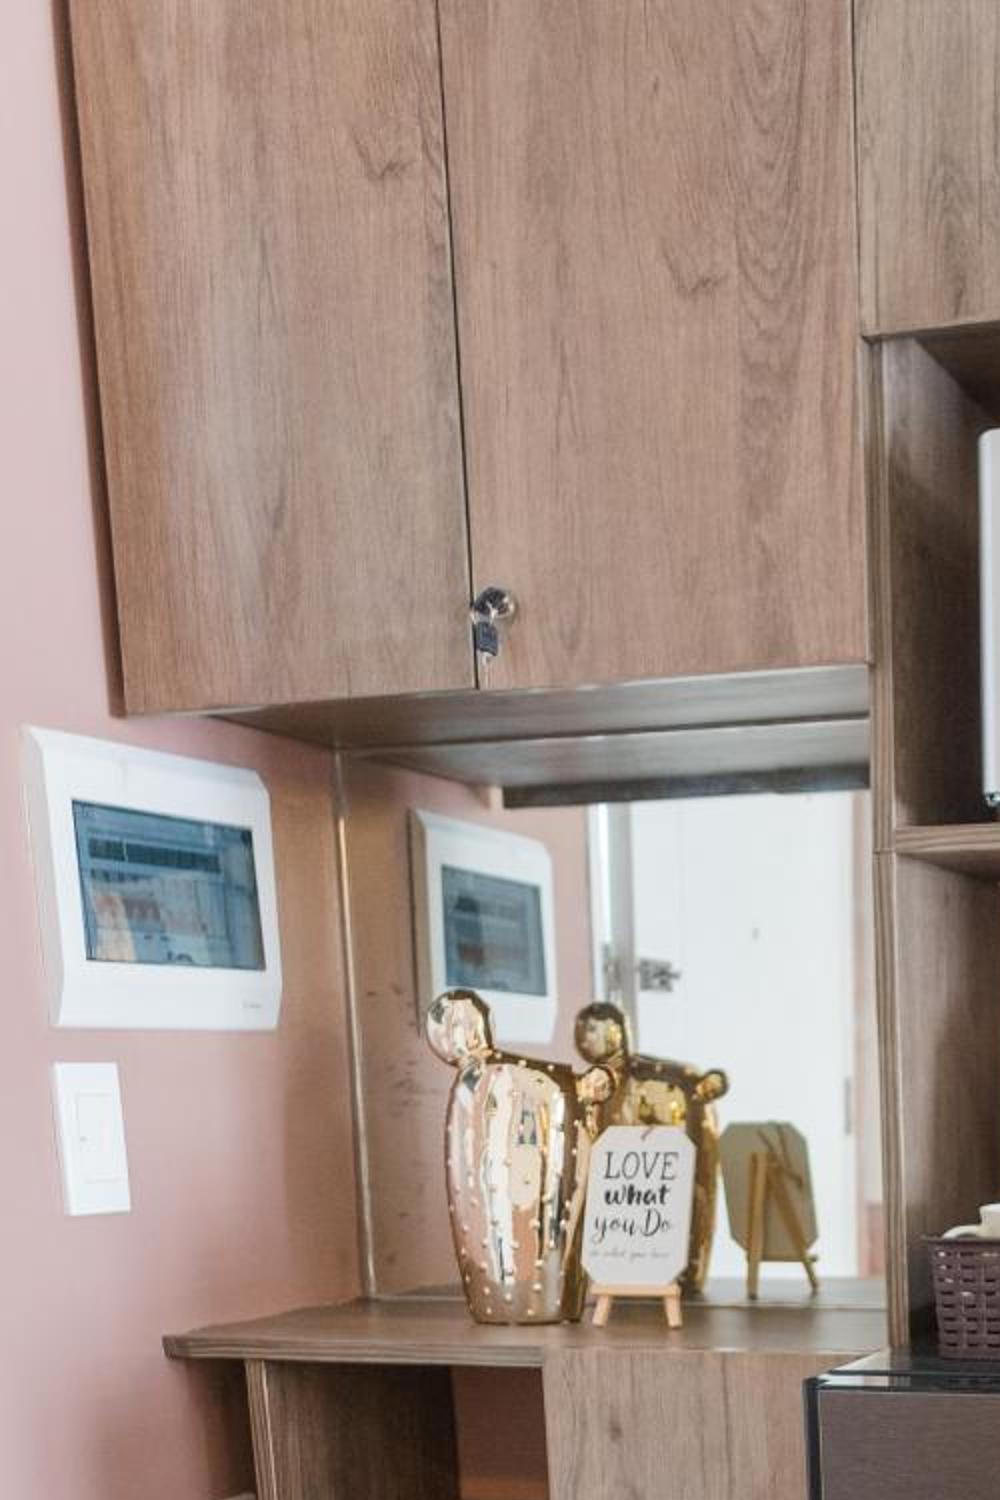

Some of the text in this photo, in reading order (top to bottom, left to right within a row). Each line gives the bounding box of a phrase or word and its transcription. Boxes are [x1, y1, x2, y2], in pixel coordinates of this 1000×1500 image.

[604, 1151, 680, 1181] LOVE
[604, 1184, 672, 1206] what
[592, 1208, 673, 1244] you Do
